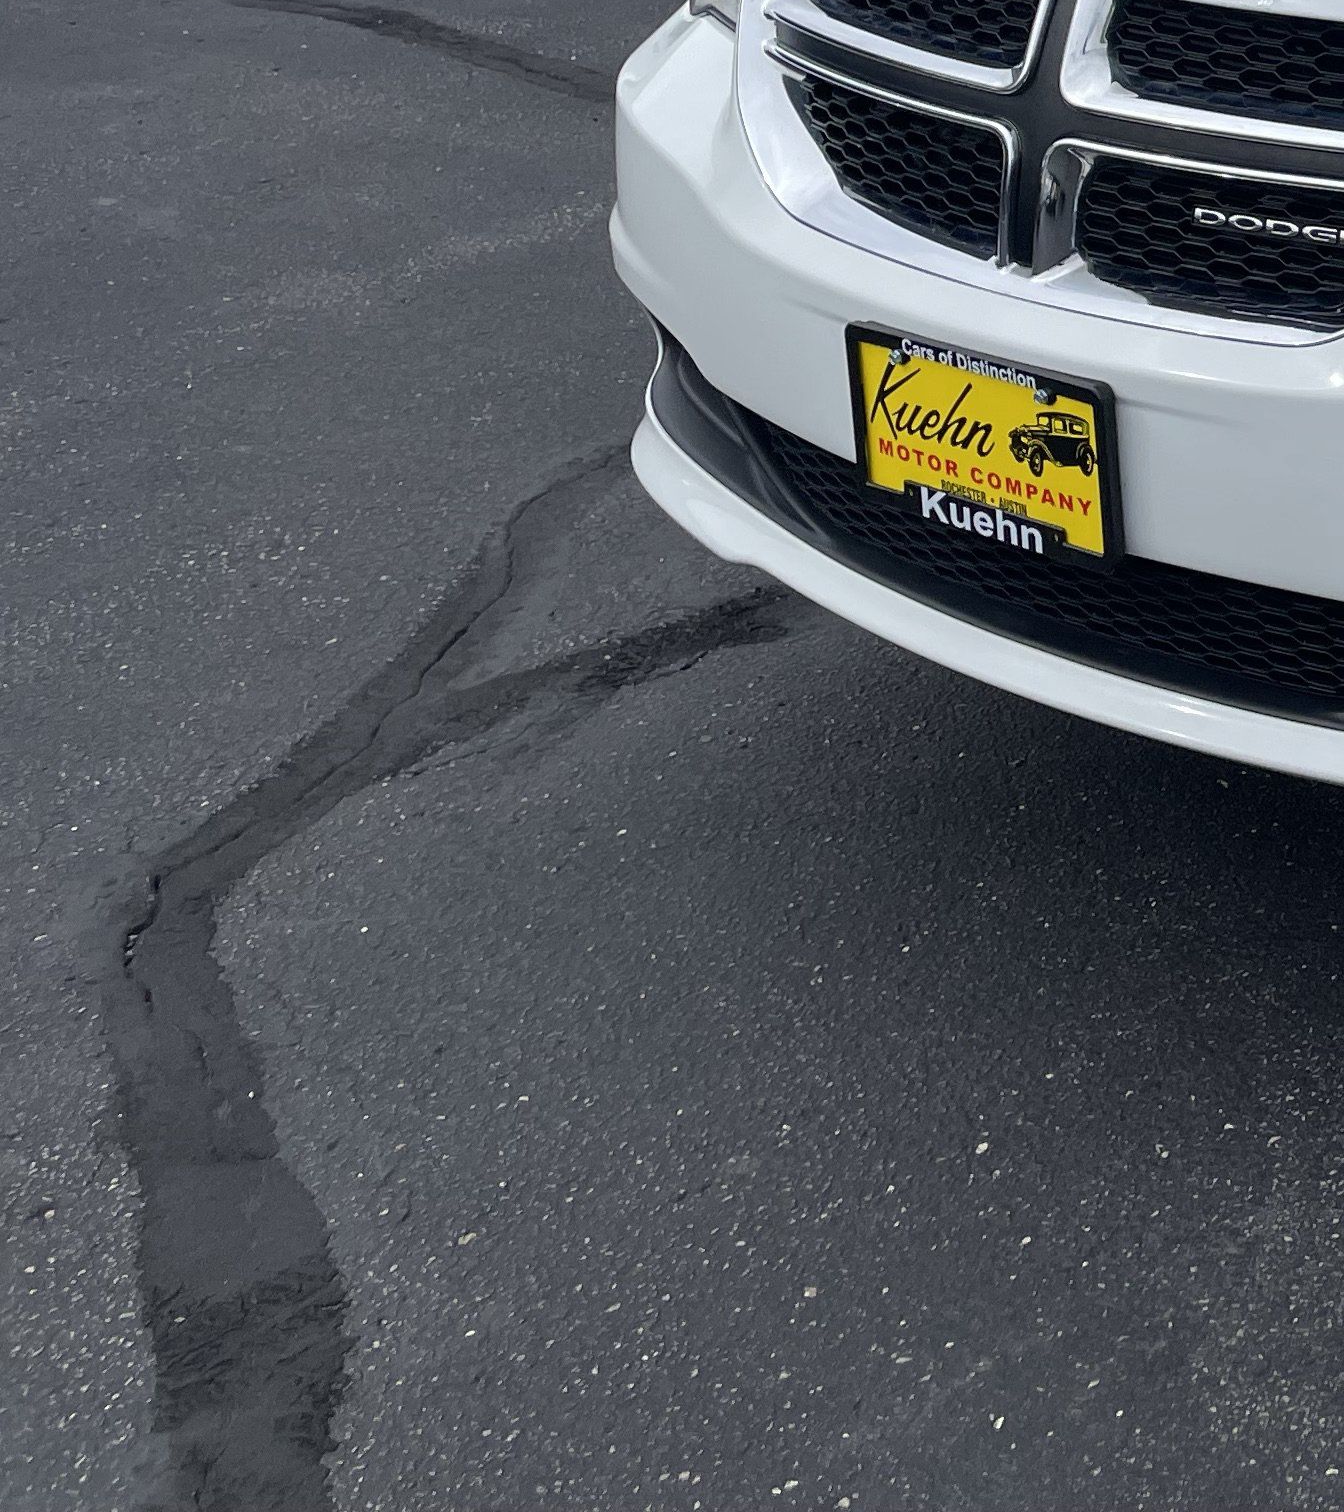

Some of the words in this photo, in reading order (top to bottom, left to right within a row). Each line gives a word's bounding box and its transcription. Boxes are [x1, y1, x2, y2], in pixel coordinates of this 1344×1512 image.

[901, 338, 936, 362] Cars
[939, 350, 954, 367] of
[956, 353, 1037, 391] Distinction
[870, 362, 995, 458] Kuehn
[878, 437, 959, 478] MOTOR
[970, 466, 1092, 517] COMPANY
[920, 486, 1044, 554] Kuehn
